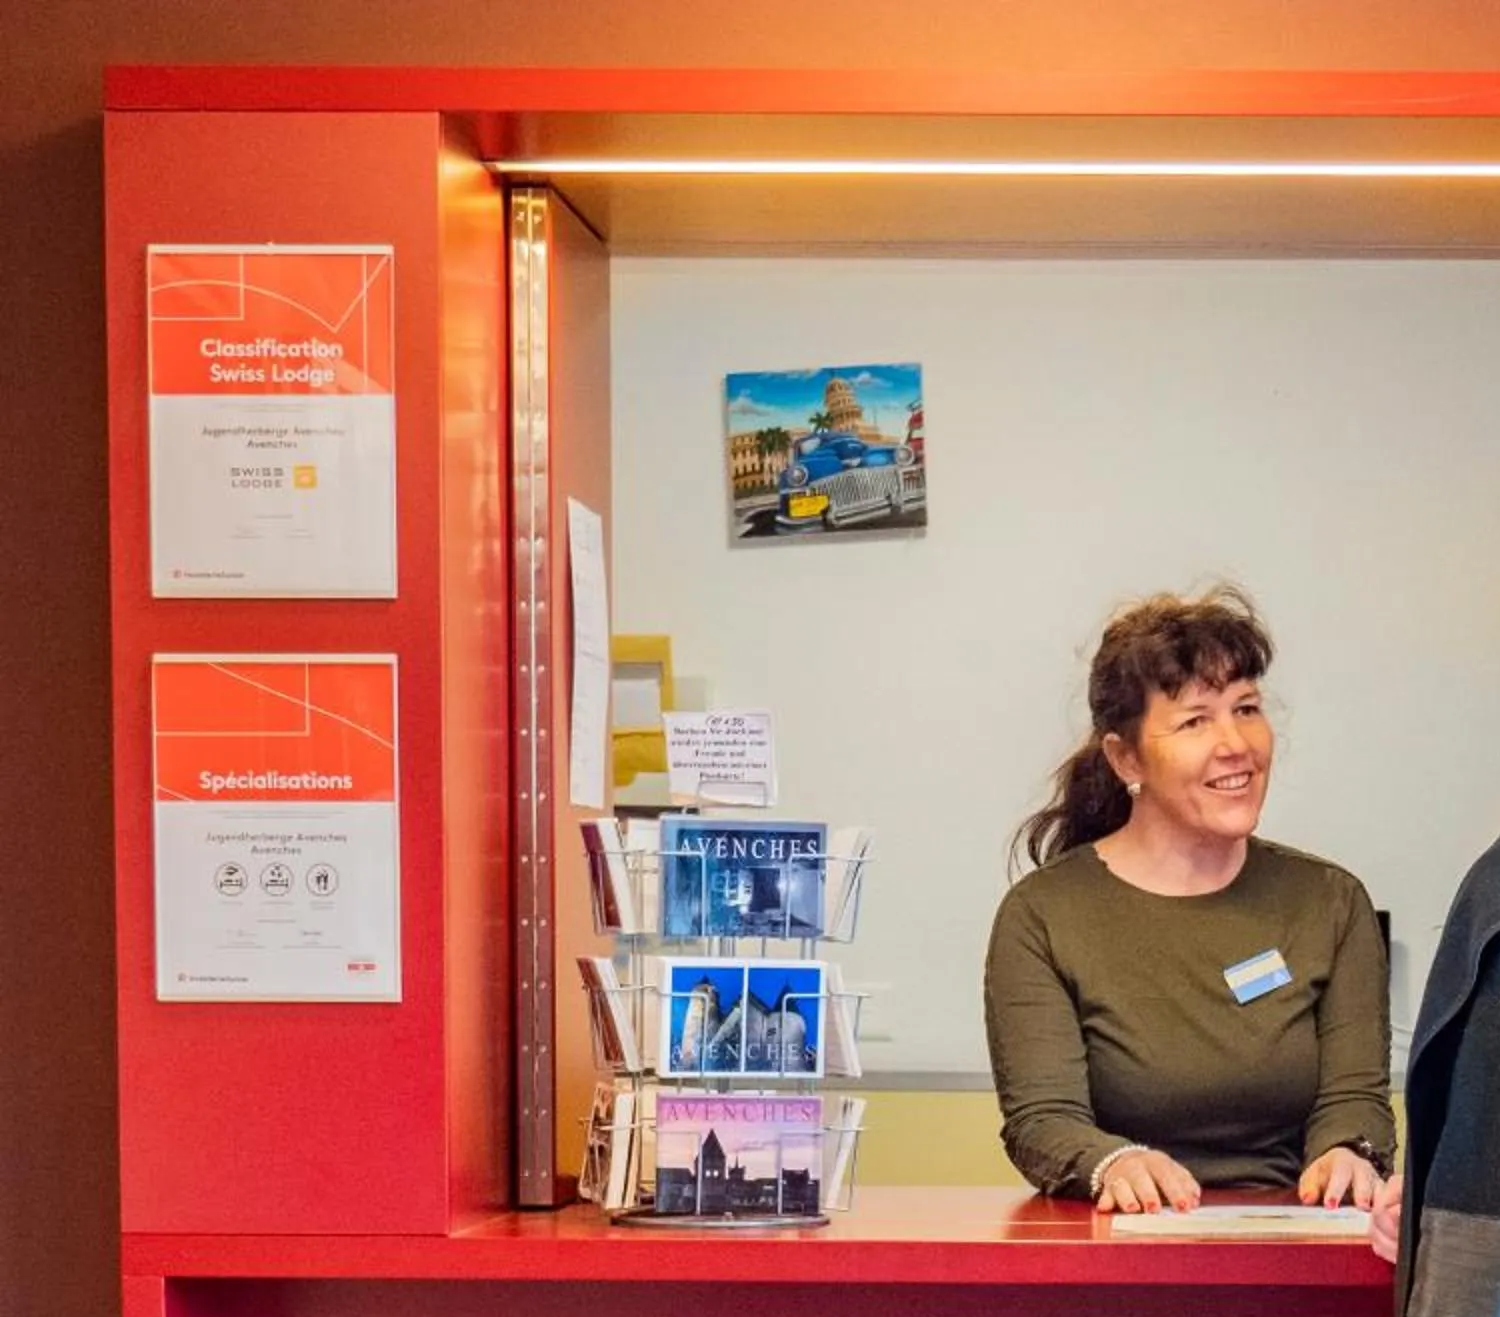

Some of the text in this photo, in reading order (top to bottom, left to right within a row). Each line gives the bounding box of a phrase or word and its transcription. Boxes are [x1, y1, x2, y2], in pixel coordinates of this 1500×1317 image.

[200, 338, 343, 358] Classification
[210, 363, 335, 387] Swiss Lodge
[231, 467, 284, 477] SWISS
[231, 479, 283, 489] LODGE
[200, 770, 353, 794] Spécialisations
[681, 837, 818, 860] AVENCHES
[667, 1102, 813, 1121] AVENCHES
